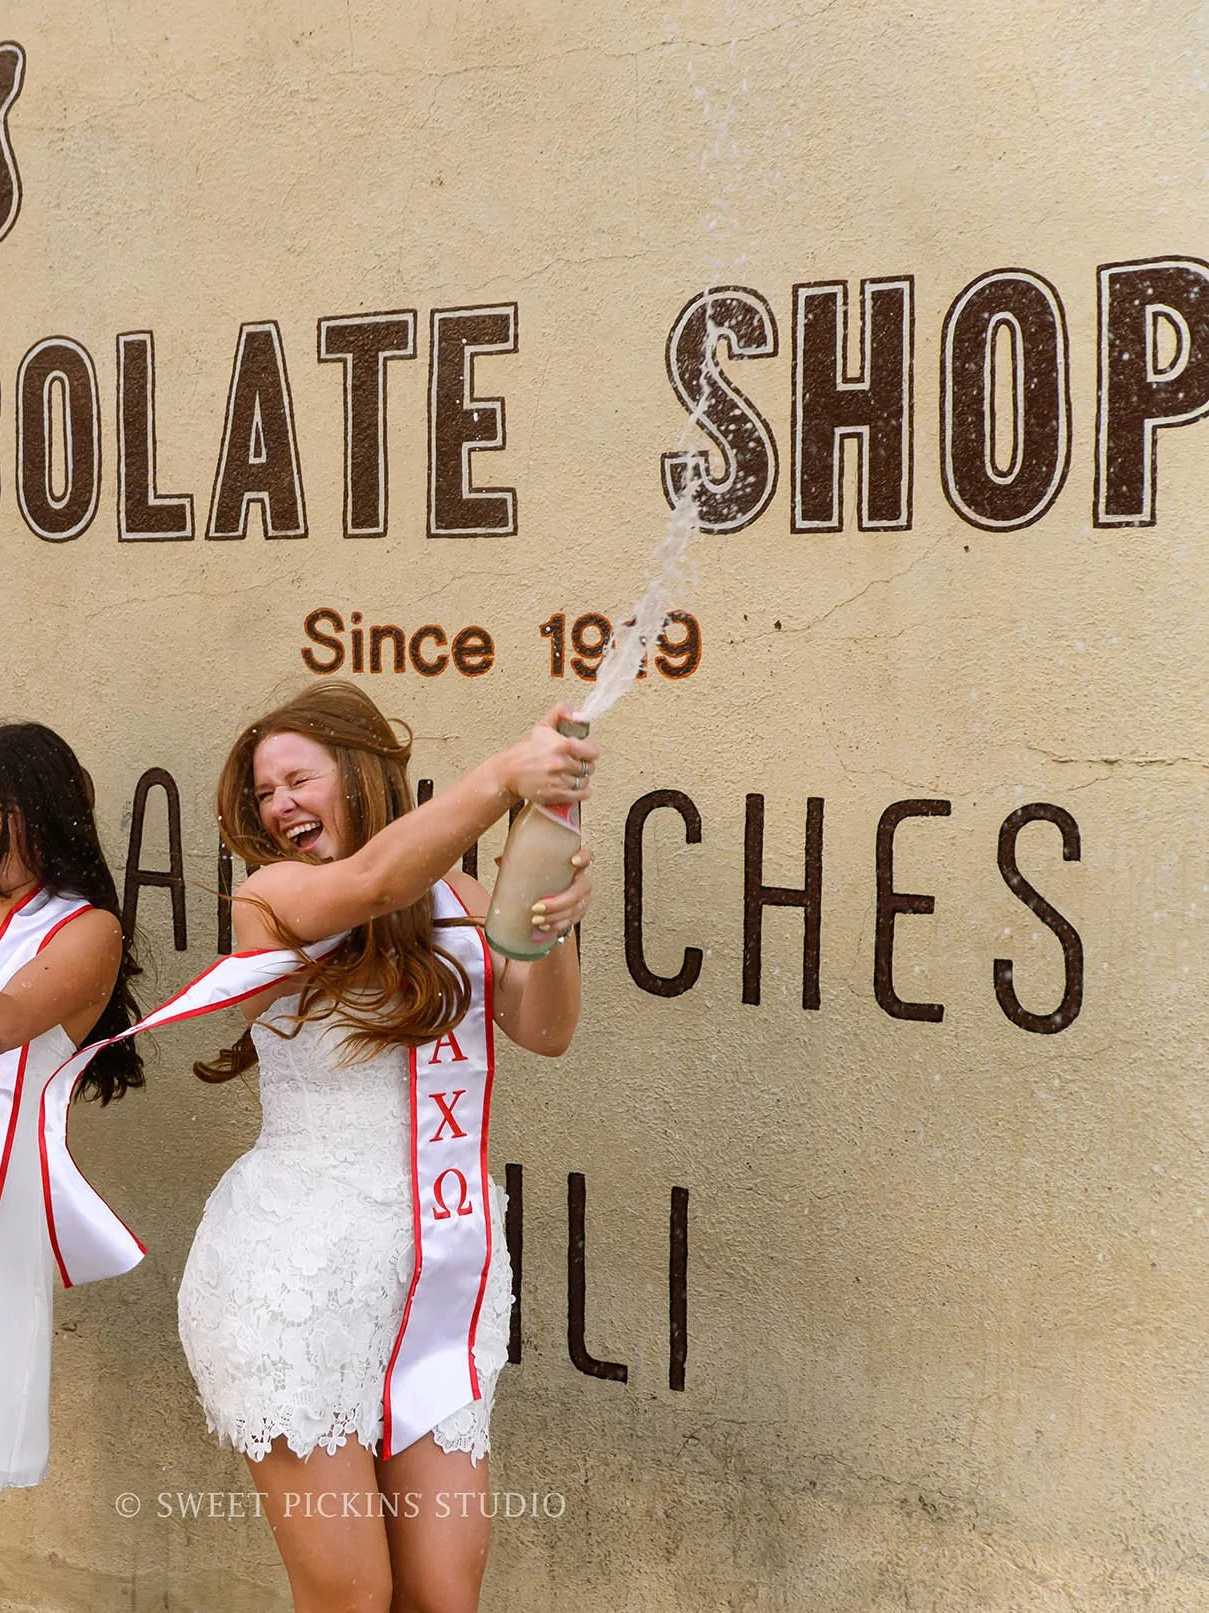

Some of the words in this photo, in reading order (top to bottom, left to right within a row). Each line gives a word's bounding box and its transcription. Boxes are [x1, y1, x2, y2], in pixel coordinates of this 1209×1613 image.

[660, 254, 1209, 534] SHOP
[301, 607, 495, 678] Since
[539, 609, 702, 682] 199
